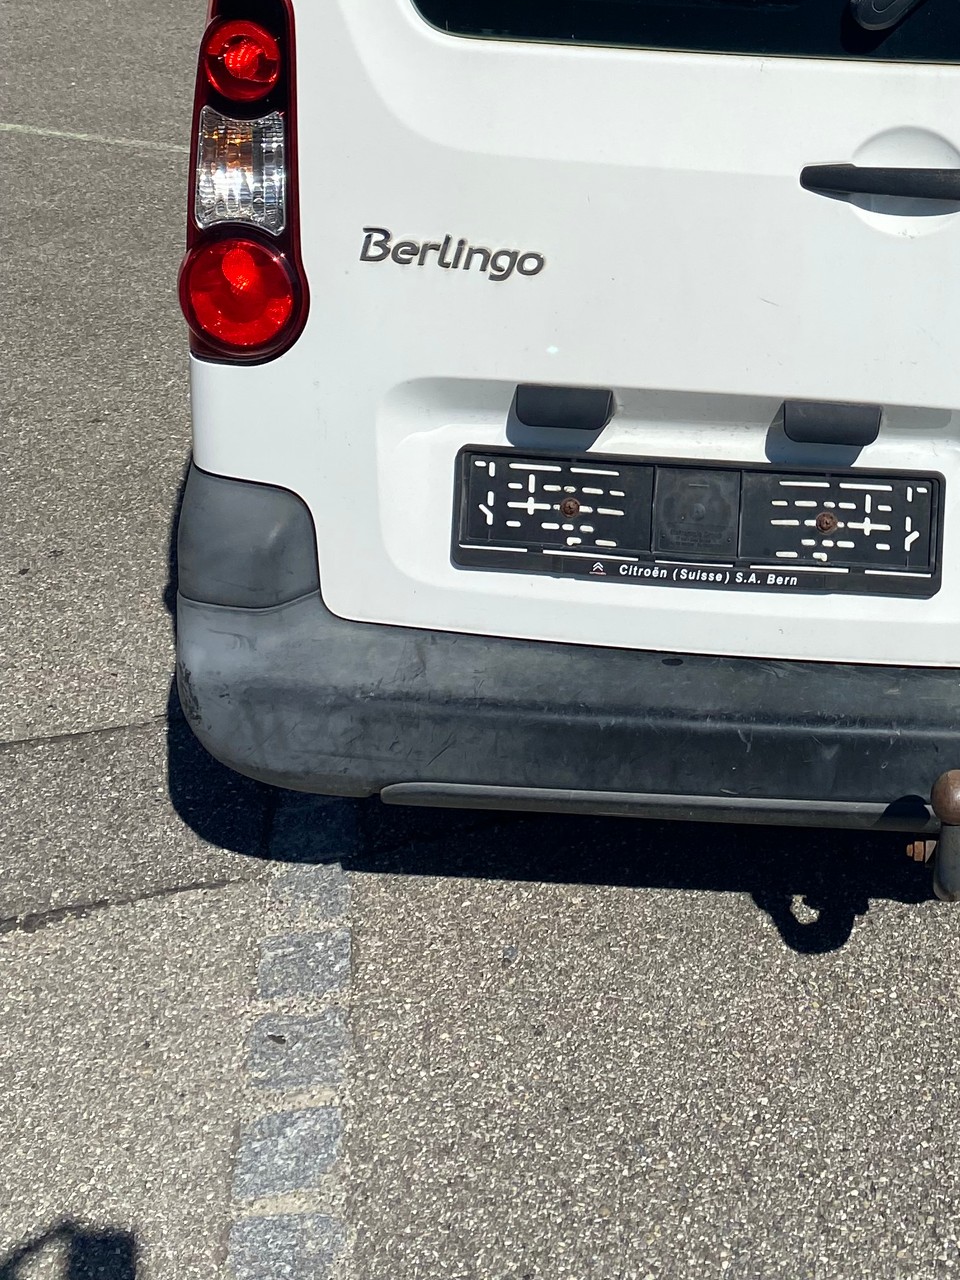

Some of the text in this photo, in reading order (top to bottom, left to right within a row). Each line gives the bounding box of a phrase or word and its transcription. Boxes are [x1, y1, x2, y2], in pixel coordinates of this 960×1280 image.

[359, 225, 545, 281] Berlingo
[618, 564, 798, 586] Citroën (Suisse) S.A. Bern
